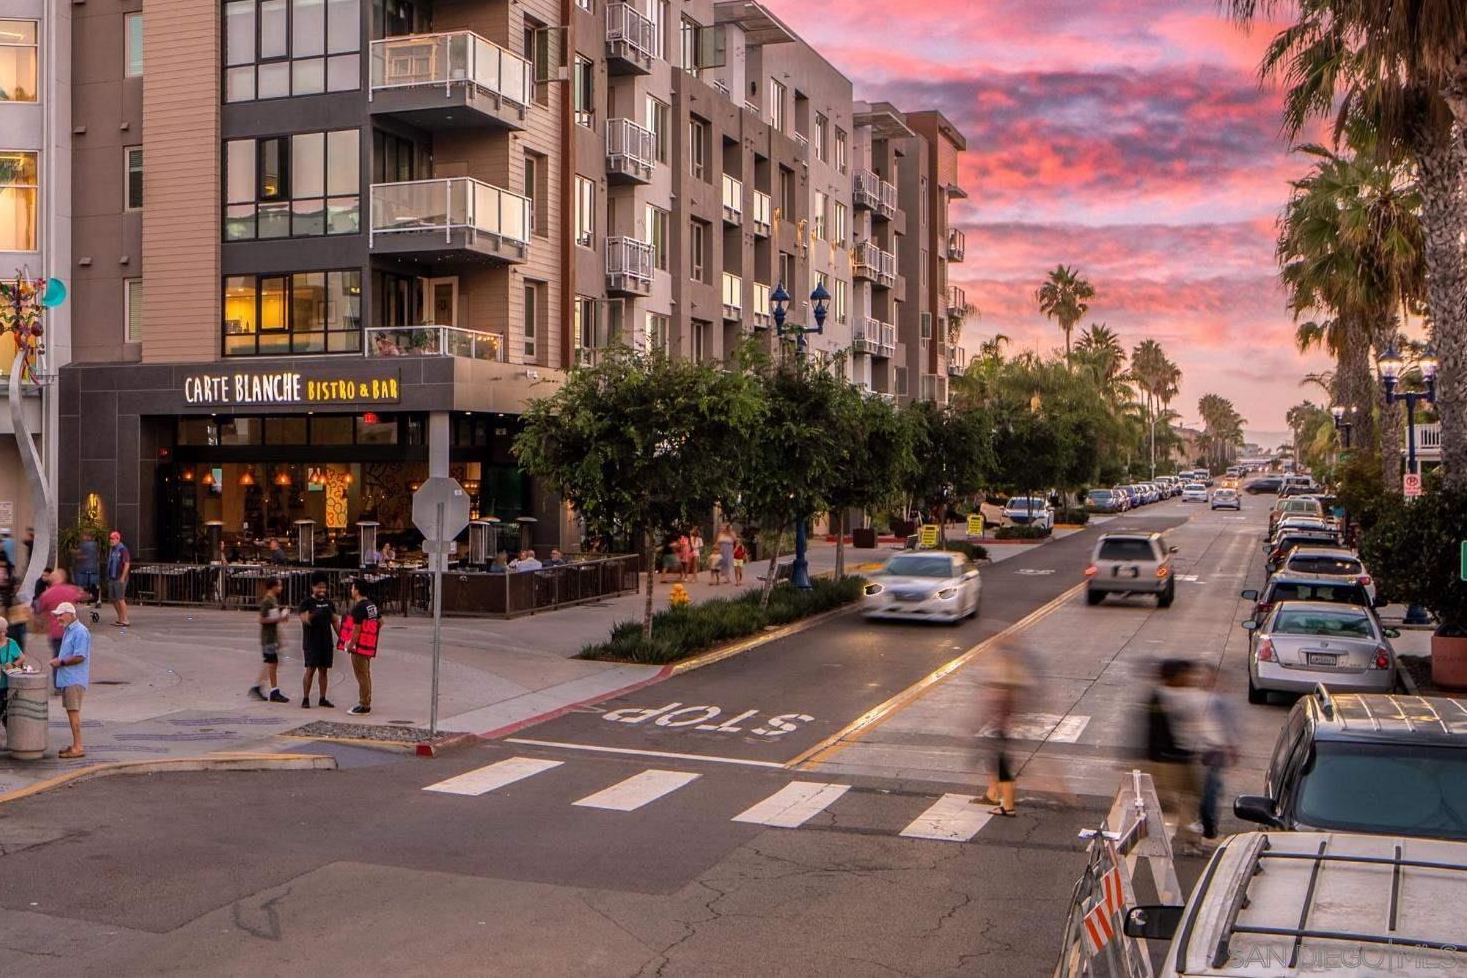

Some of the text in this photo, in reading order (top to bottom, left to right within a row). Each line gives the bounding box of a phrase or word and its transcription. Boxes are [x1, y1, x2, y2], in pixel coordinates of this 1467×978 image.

[185, 373, 398, 403] CARTE BLANCHE BISTRO & BAR
[601, 702, 816, 736] STOP
